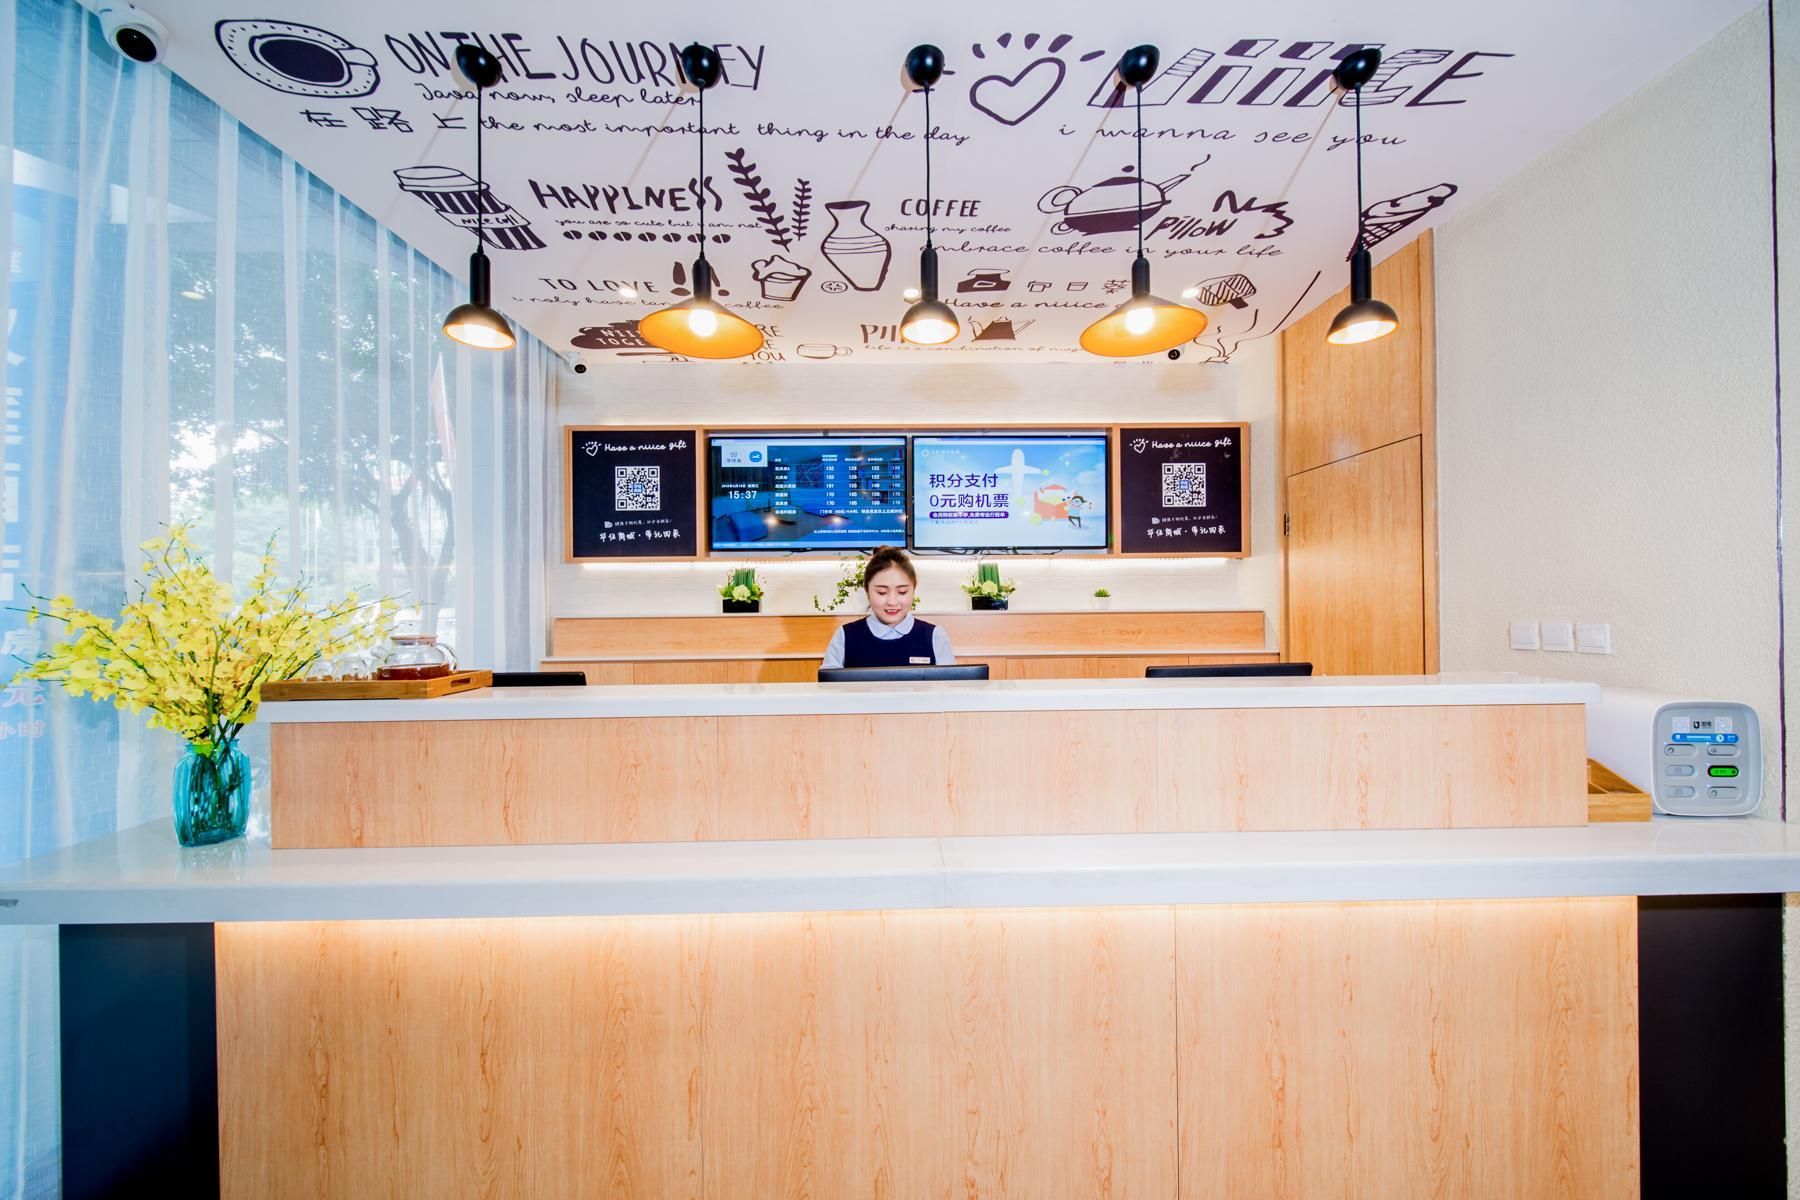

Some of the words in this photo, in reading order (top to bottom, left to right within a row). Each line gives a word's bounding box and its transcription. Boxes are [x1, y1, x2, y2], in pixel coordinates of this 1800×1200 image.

[557, 35, 765, 90] JOURNEY
[414, 82, 479, 101] Java
[566, 86, 634, 107] sleep
[640, 88, 702, 104] later
[299, 106, 468, 133] 在路上
[480, 116, 525, 131] the
[533, 119, 597, 134] most
[605, 121, 741, 137] important
[757, 122, 829, 143] thing
[838, 127, 868, 139] in
[875, 125, 915, 141] the
[923, 126, 970, 146] day
[1058, 124, 1075, 136] i
[1095, 126, 1236, 141] wanna
[1253, 129, 1313, 144] see
[1326, 132, 1407, 151] you
[528, 175, 723, 214] HAPPINESS
[900, 198, 981, 217] COFFEE
[554, 218, 586, 227] you
[634, 219, 666, 227] cute
[737, 221, 763, 229] not
[884, 223, 938, 234] sharing
[941, 226, 966, 234] my
[970, 224, 1013, 233] coffee
[1038, 241, 1116, 256] coffee
[1125, 246, 1152, 255] in
[1164, 247, 1227, 259] your
[1236, 244, 1284, 258] life
[538, 277, 578, 291] TO
[586, 279, 660, 293] LOVE
[724, 300, 785, 310] coffee
[943, 297, 1007, 309] Have
[1010, 301, 1027, 309] a
[604, 443, 629, 452] Have
[669, 439, 688, 451] gift
[1151, 440, 1175, 449] Have
[1176, 440, 1183, 448] a
[1214, 436, 1232, 448] gift
[929, 473, 999, 489] 积分支付
[728, 490, 758, 500] 15:37
[929, 493, 1009, 508] 0元购机票
